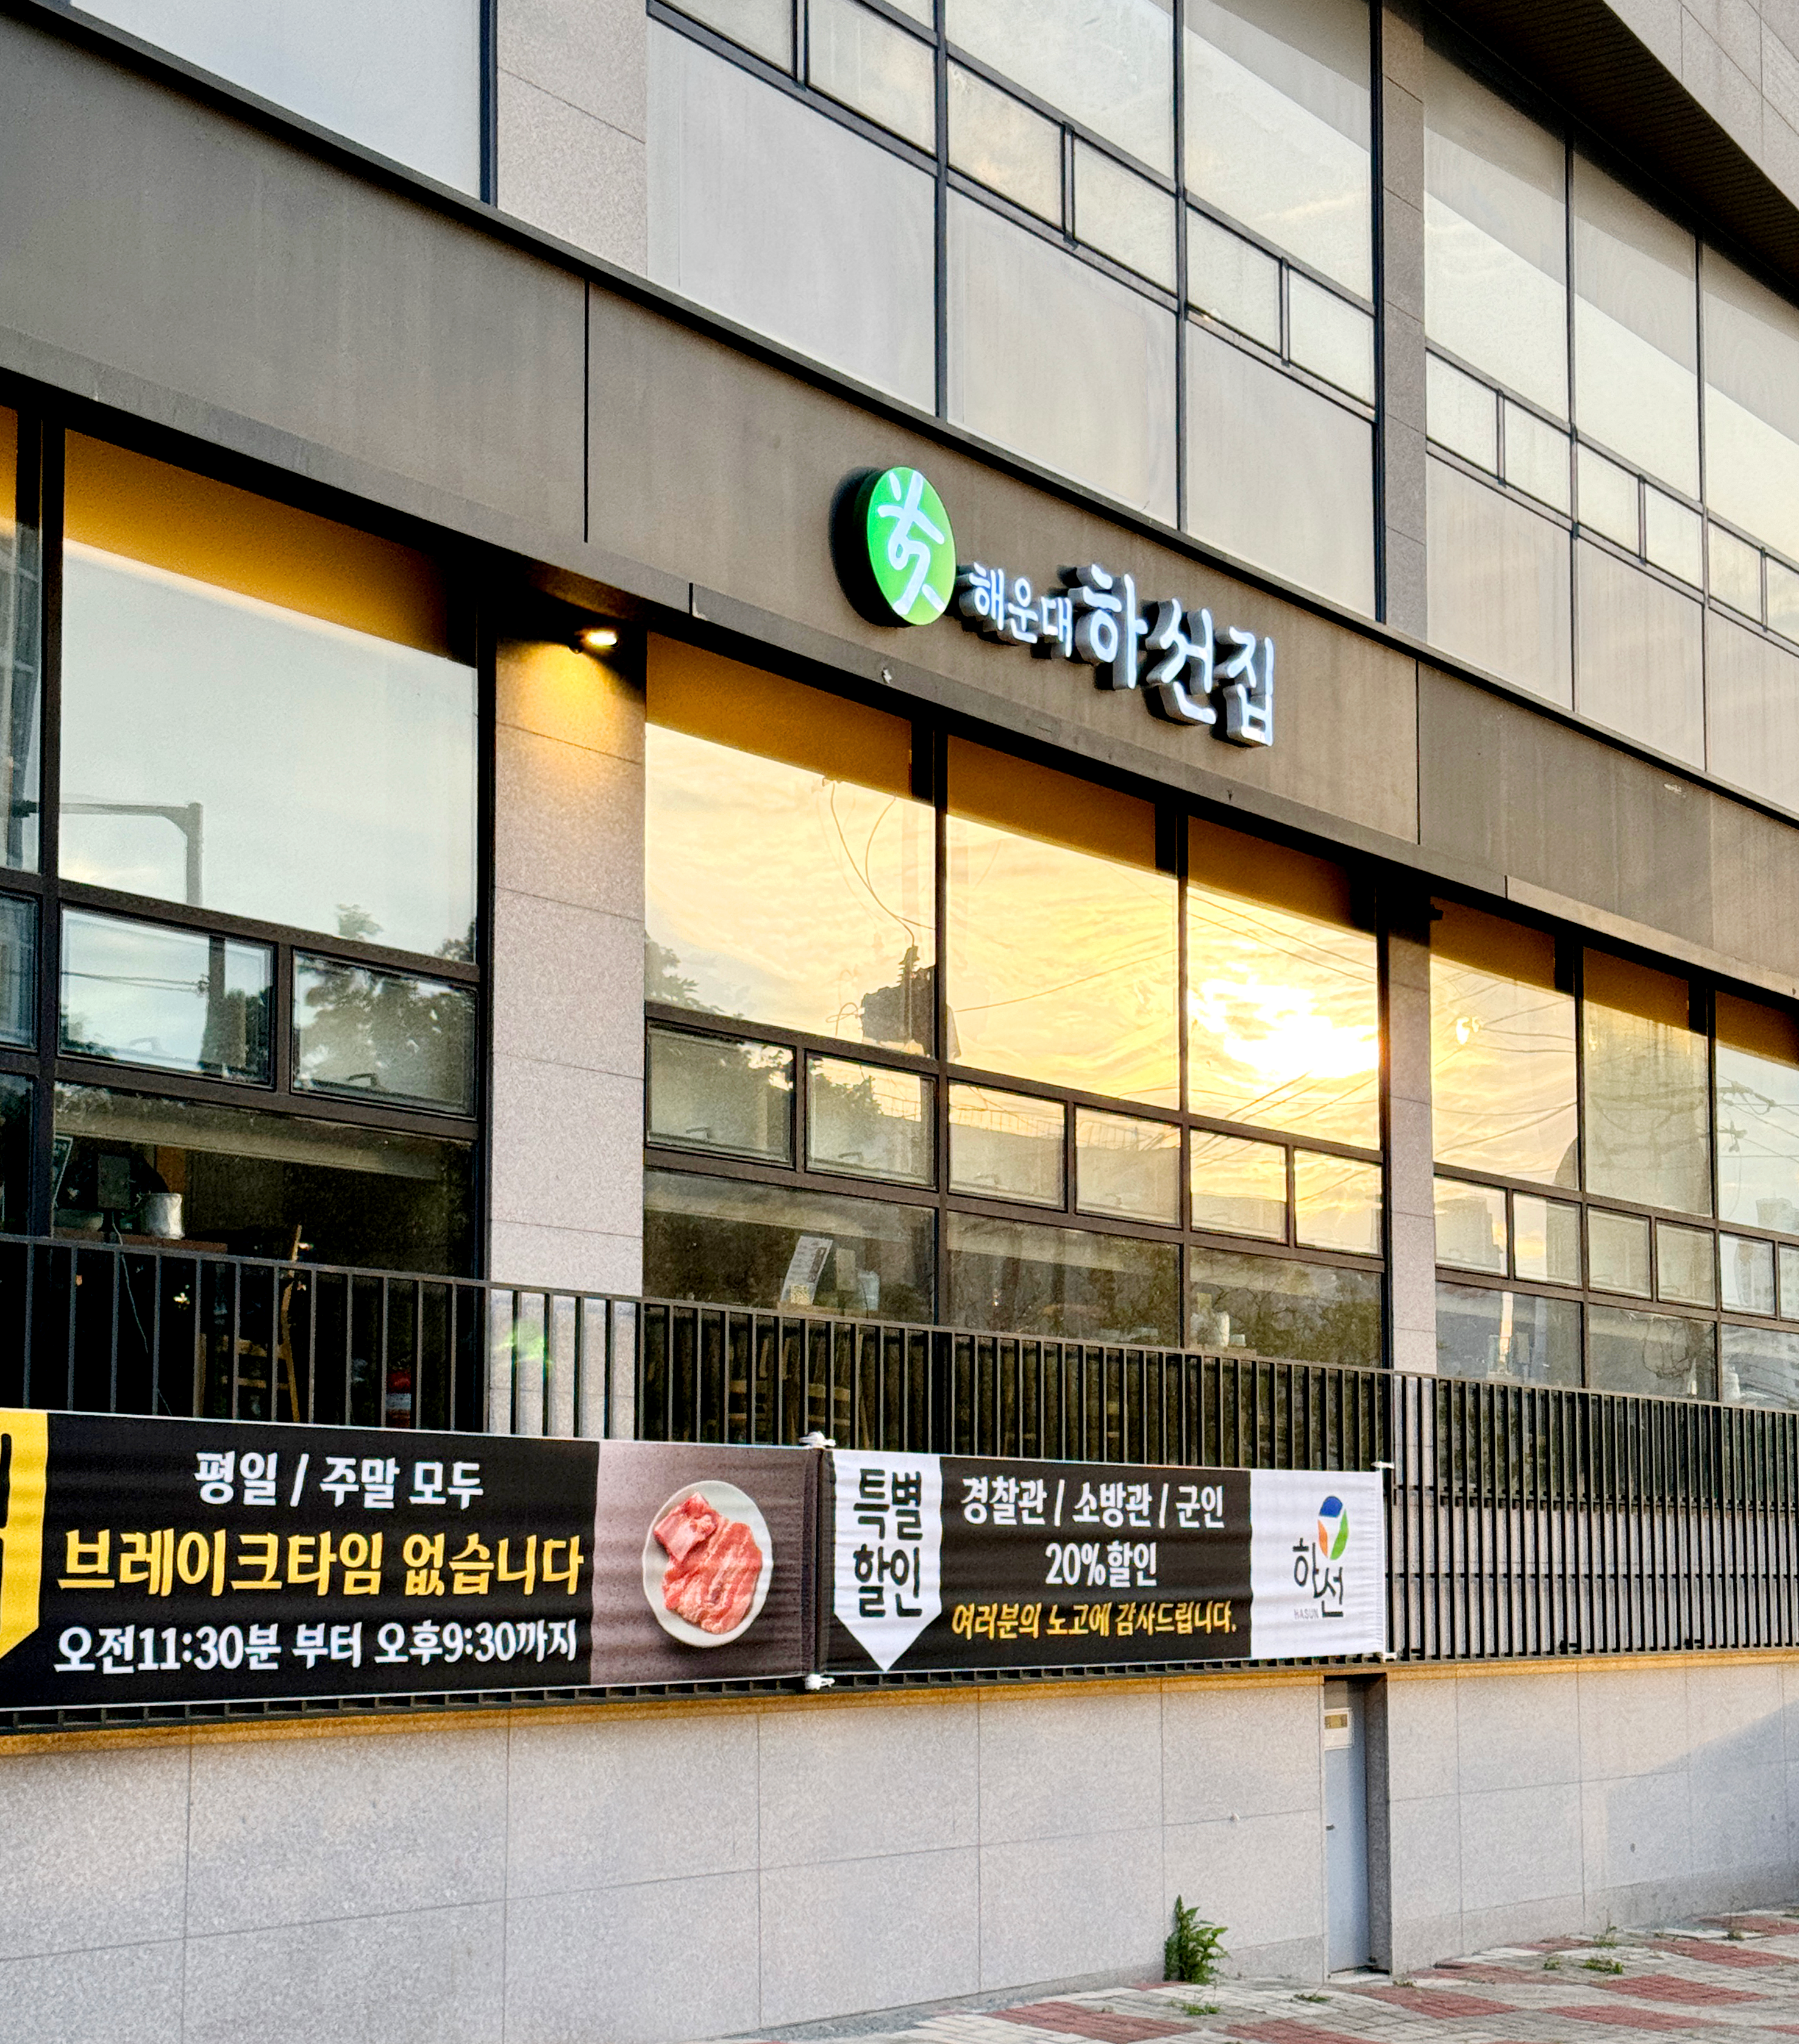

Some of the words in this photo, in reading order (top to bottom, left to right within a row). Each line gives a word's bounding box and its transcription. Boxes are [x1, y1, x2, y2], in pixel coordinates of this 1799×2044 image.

[970, 562, 1072, 658] 해운대
[1082, 563, 1275, 747] 하선집
[194, 1451, 277, 1506] 평일
[290, 1454, 309, 1506] /
[320, 1457, 400, 1509] 주말
[409, 1462, 483, 1509] 모두
[853, 1469, 922, 1540] 특별
[961, 1476, 1047, 1525] 경찰관
[1054, 1479, 1065, 1527] /
[1072, 1482, 1152, 1528] 소방관
[1159, 1483, 1169, 1529] /
[1176, 1485, 1224, 1528] 군인
[58, 1528, 383, 1596] 브레이크타임
[403, 1533, 583, 1596] 없습니다
[853, 1544, 922, 1617] 할인
[1292, 1537, 1344, 1618] 하선
[952, 1603, 1041, 1640] 여러분의
[1046, 1602, 1112, 1636] 노고에
[1116, 1601, 1236, 1635] 감사드립니다.
[1294, 1608, 1319, 1620] HASUN
[54, 1624, 281, 1674] 오전11:30분
[293, 1622, 362, 1669] 부터
[375, 1619, 576, 1665] 오후9:30까지
